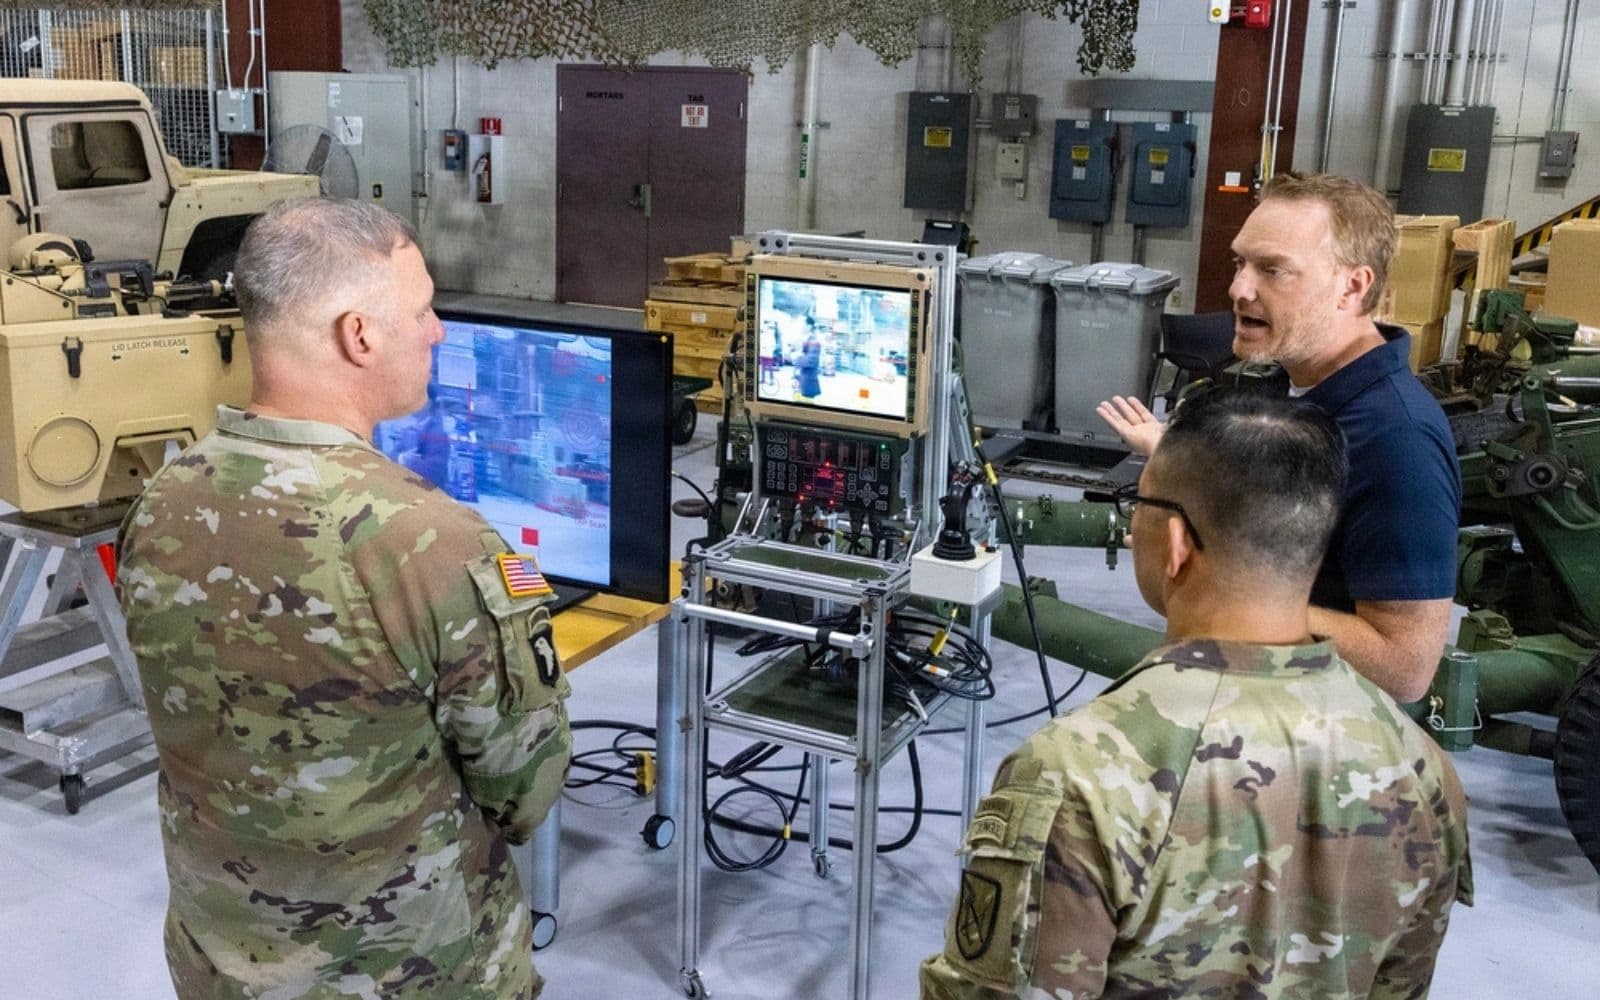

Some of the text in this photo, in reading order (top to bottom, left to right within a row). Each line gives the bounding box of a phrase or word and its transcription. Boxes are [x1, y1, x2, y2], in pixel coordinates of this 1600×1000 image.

[111, 337, 188, 352] LID LATCH RELEASE
